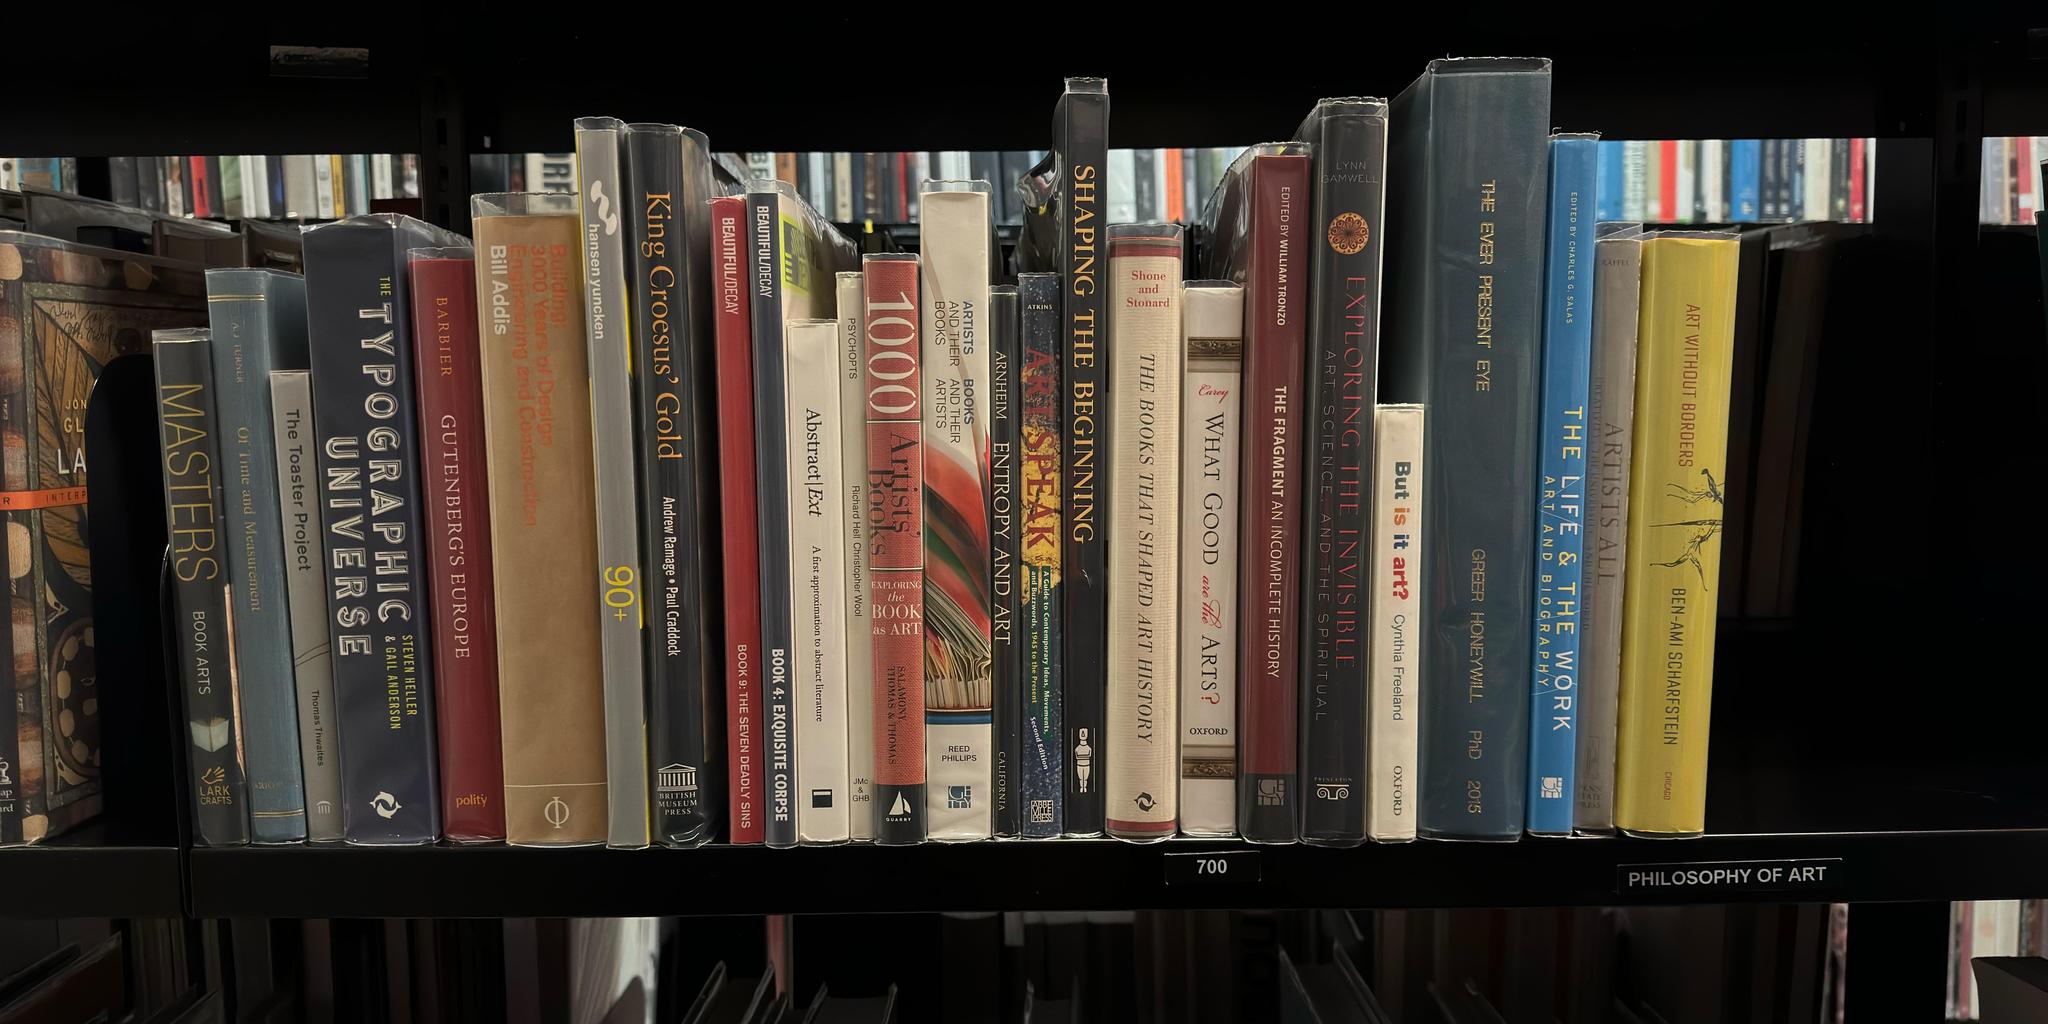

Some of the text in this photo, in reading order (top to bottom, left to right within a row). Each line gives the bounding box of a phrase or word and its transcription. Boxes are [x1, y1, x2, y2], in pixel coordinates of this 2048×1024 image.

[1336, 160, 1367, 170] LYNN
[379, 276, 392, 296] THE
[490, 245, 511, 336] Bill Addis
[531, 245, 548, 292] 3000
[589, 224, 605, 340] hansen yuncken
[721, 218, 739, 315] BEAUTIFUL/DECAY
[756, 206, 773, 298] BEAUTIFUL/DECAY
[1131, 270, 1166, 281] Shone
[1138, 283, 1159, 294] and
[1276, 186, 1291, 326] EDITED BY WILLIAM TRONZO
[1476, 179, 1496, 392] THE EVER PRESENT EYE
[1565, 191, 1578, 324] EDITED CHARLES SALAS
[436, 297, 452, 377] BARBIER
[642, 191, 684, 460] King Gold
[934, 301, 946, 346] BOOKS
[949, 301, 960, 367] AND THEIR
[963, 301, 974, 355] ARTISTS
[1126, 297, 1170, 308] Stonard
[848, 317, 858, 380] PSYCHOPTS
[867, 291, 917, 414] 1000
[1073, 165, 1096, 544] SHAPING THE BEGINNING
[1678, 304, 1701, 467] ART WITHOUT BORDERS
[935, 378, 947, 429] ARTISTS
[949, 379, 961, 444] AND THEIR
[963, 379, 975, 425] BOOKS
[1198, 383, 1229, 405] Carey
[160, 384, 218, 582] MASTERS
[241, 490, 256, 515] and
[285, 409, 311, 571] The Toaster Project
[358, 302, 412, 623] TYPOGRAPHIC
[994, 350, 1011, 645] ARNHEIM ENTROPY AND ART
[1336, 276, 1366, 669] EXPLORING THE INVISIBLE
[1202, 411, 1225, 630] WHAT GOOD are the
[1267, 386, 1287, 678] THE FRAGMENT AN INCOMPLETE HISTORY
[1393, 461, 1411, 600] But is it art?
[1597, 422, 1625, 586] ARTISTS ALL
[325, 436, 373, 656] UNIVERSE
[662, 496, 682, 657] Andrew Ramage Paul Craddock
[851, 485, 863, 617] Richard Hell Christopher Wool
[871, 581, 922, 590] EXPLORING
[1137, 353, 1155, 744] THE BOOKS THAT SHAPED ART HISTORY
[1538, 475, 1555, 686] ART AND BIOGRAPHY
[1553, 405, 1582, 731] THE LIFE THE WORK
[450, 574, 470, 659] EUROPE
[872, 604, 921, 619] BOOK
[887, 592, 905, 602] the
[889, 622, 922, 636] ART
[1315, 513, 1332, 721] AND THE SPIRITUAL
[1469, 548, 1486, 704] GREER HONEYWILL
[192, 611, 211, 695] BOOK ARTS
[402, 635, 418, 716] STEVEN HELLER
[810, 556, 825, 722] first approximation abstract literature
[1041, 612, 1050, 665] Contemporary
[1042, 667, 1051, 688] Ideas,
[1391, 614, 1405, 720] Cynthia Freeland
[1664, 588, 1687, 745] BEN-AMI SCHARFSTEIN
[311, 690, 324, 767] Thomas Thwaites
[386, 646, 401, 730] GAIL ANDERSON
[887, 666, 896, 765] THOMAS THOMAS
[737, 644, 751, 829] BOOK THE SEVEN DEADLY SINS
[772, 649, 789, 822] BOOK EXQUISITE CORPSE
[948, 745, 970, 753] REED
[1189, 727, 1228, 736] OXFORD
[1467, 730, 1483, 760] PhD
[200, 785, 229, 796] LARK
[200, 796, 233, 805] CRAFTS
[455, 792, 488, 807] polity
[658, 791, 696, 800] BRITISH
[658, 799, 698, 808] MUSEUM
[664, 808, 692, 816] PRESS
[998, 751, 1006, 811] CALIFORNIA
[1393, 765, 1403, 816] OXFORD
[1467, 780, 1482, 814] 2015
[1197, 859, 1227, 874] 700
[1629, 866, 1827, 887] PHILOSOPHY OF ART
